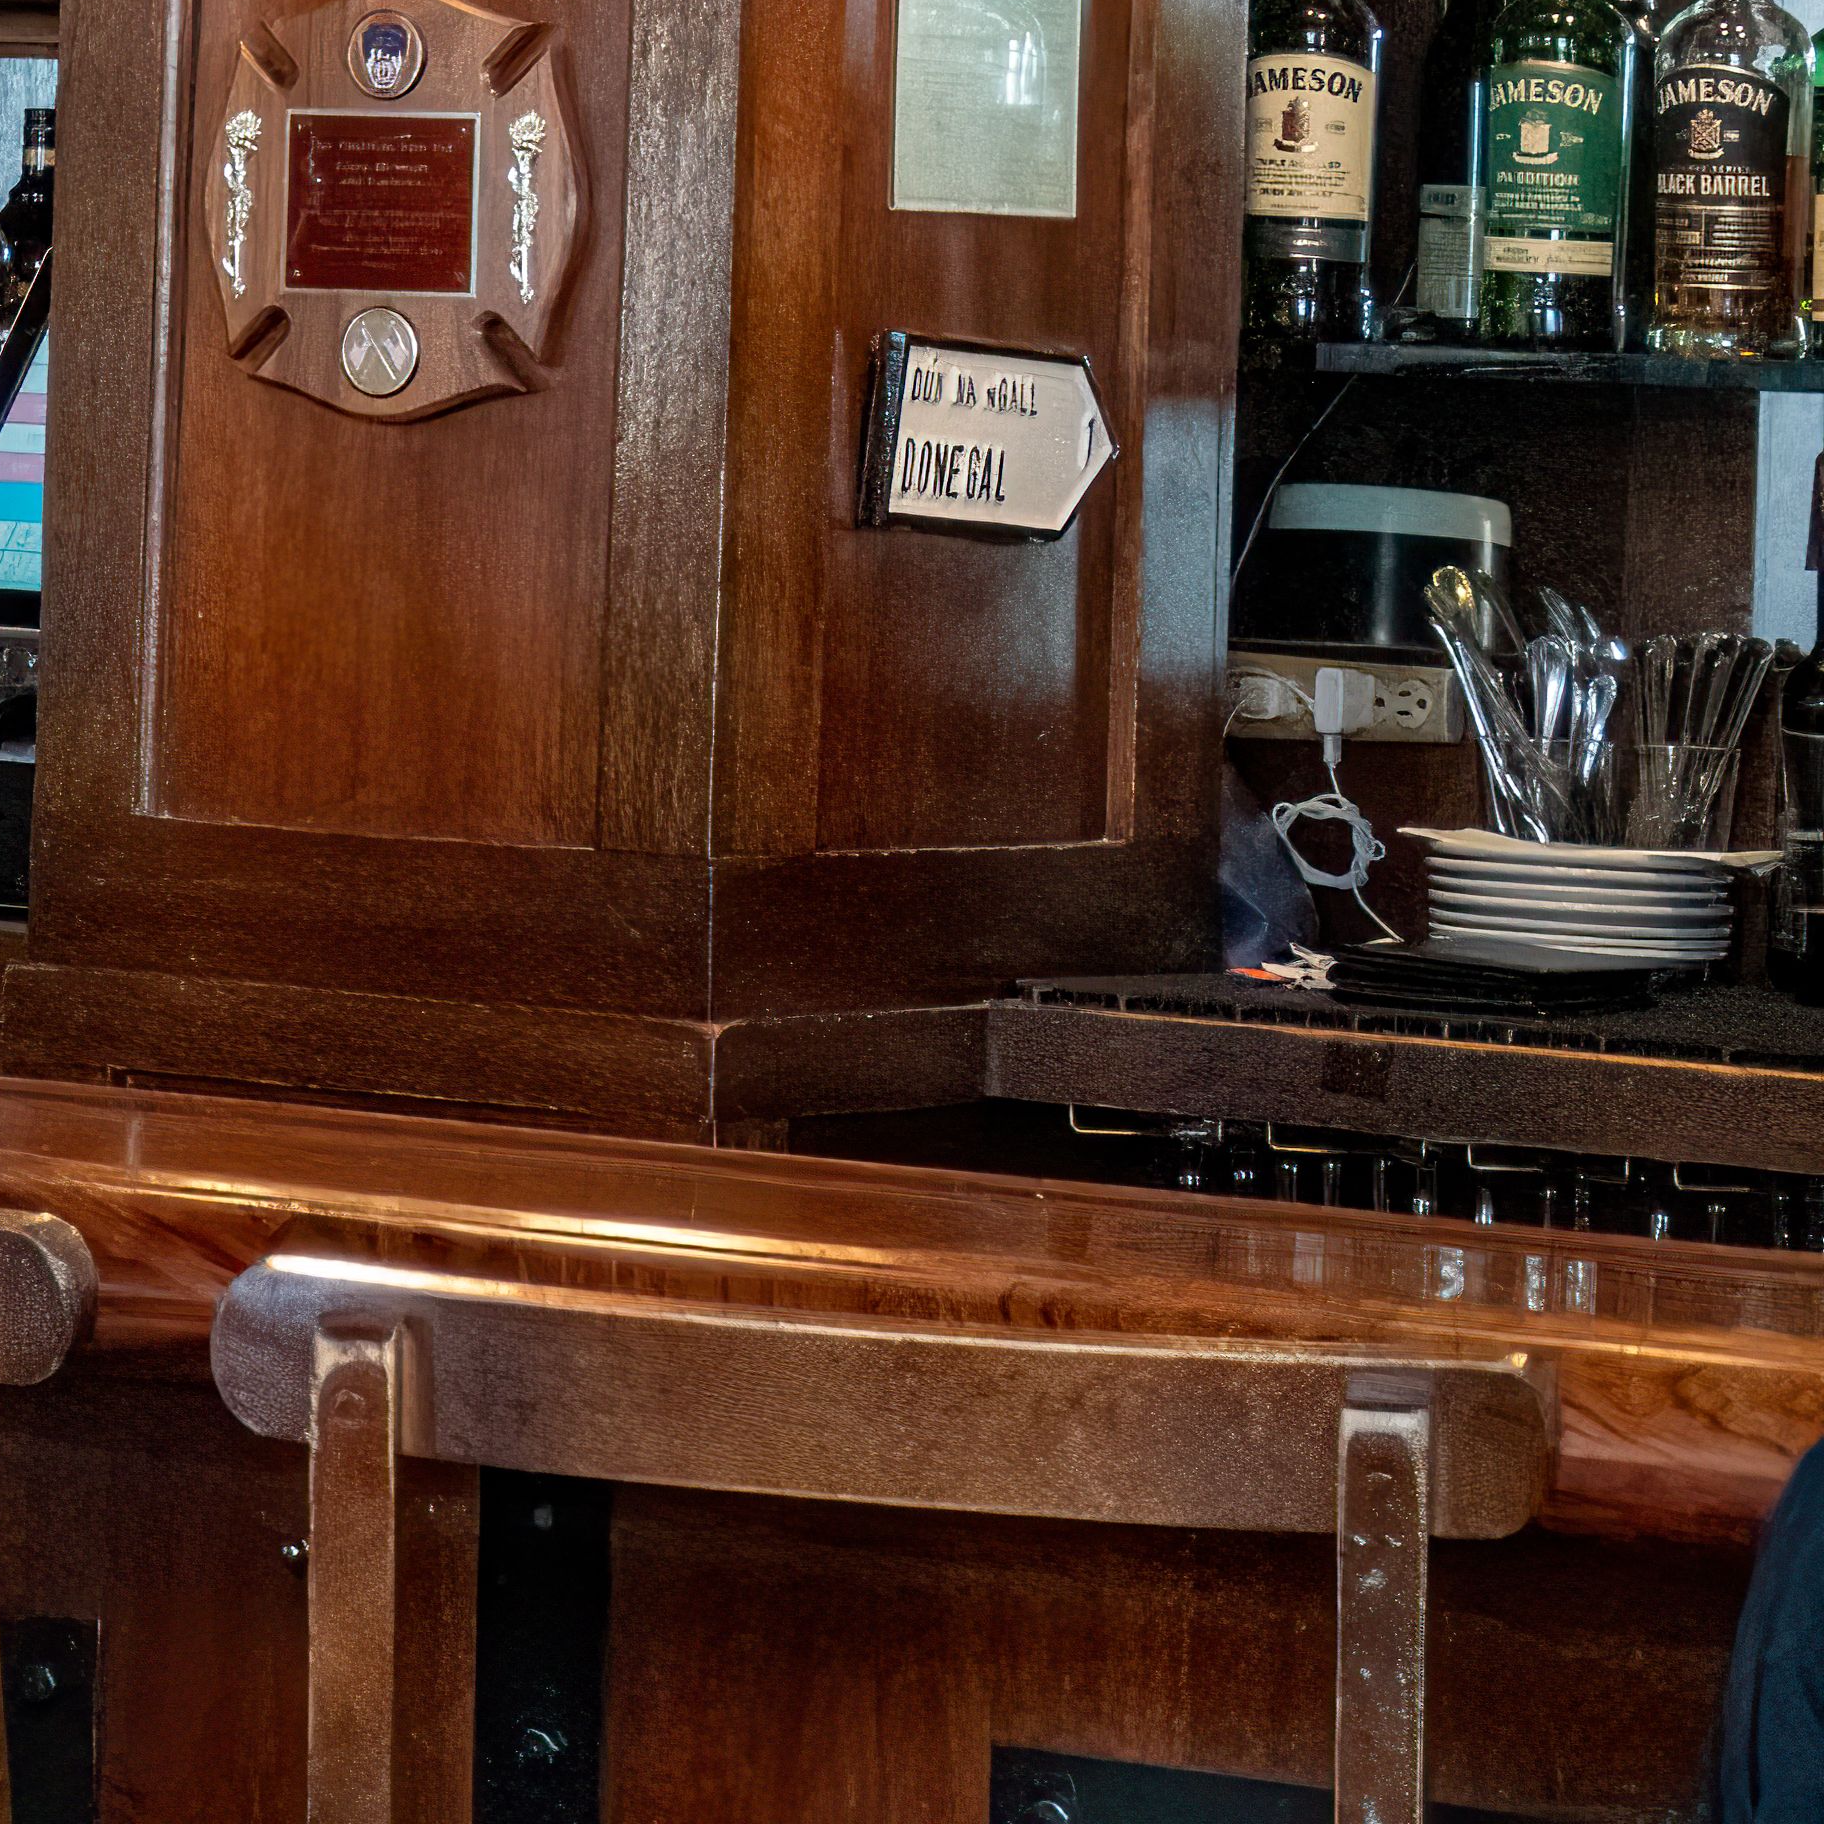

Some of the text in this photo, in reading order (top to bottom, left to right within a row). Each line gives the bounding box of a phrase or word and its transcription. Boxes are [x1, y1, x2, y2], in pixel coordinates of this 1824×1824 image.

[1250, 67, 1363, 104] AMESON
[1488, 77, 1603, 116] JAMESON
[1657, 78, 1774, 117] JAMESON
[1700, 174, 1771, 197] BARREL
[901, 437, 1006, 503] DONEGAL
